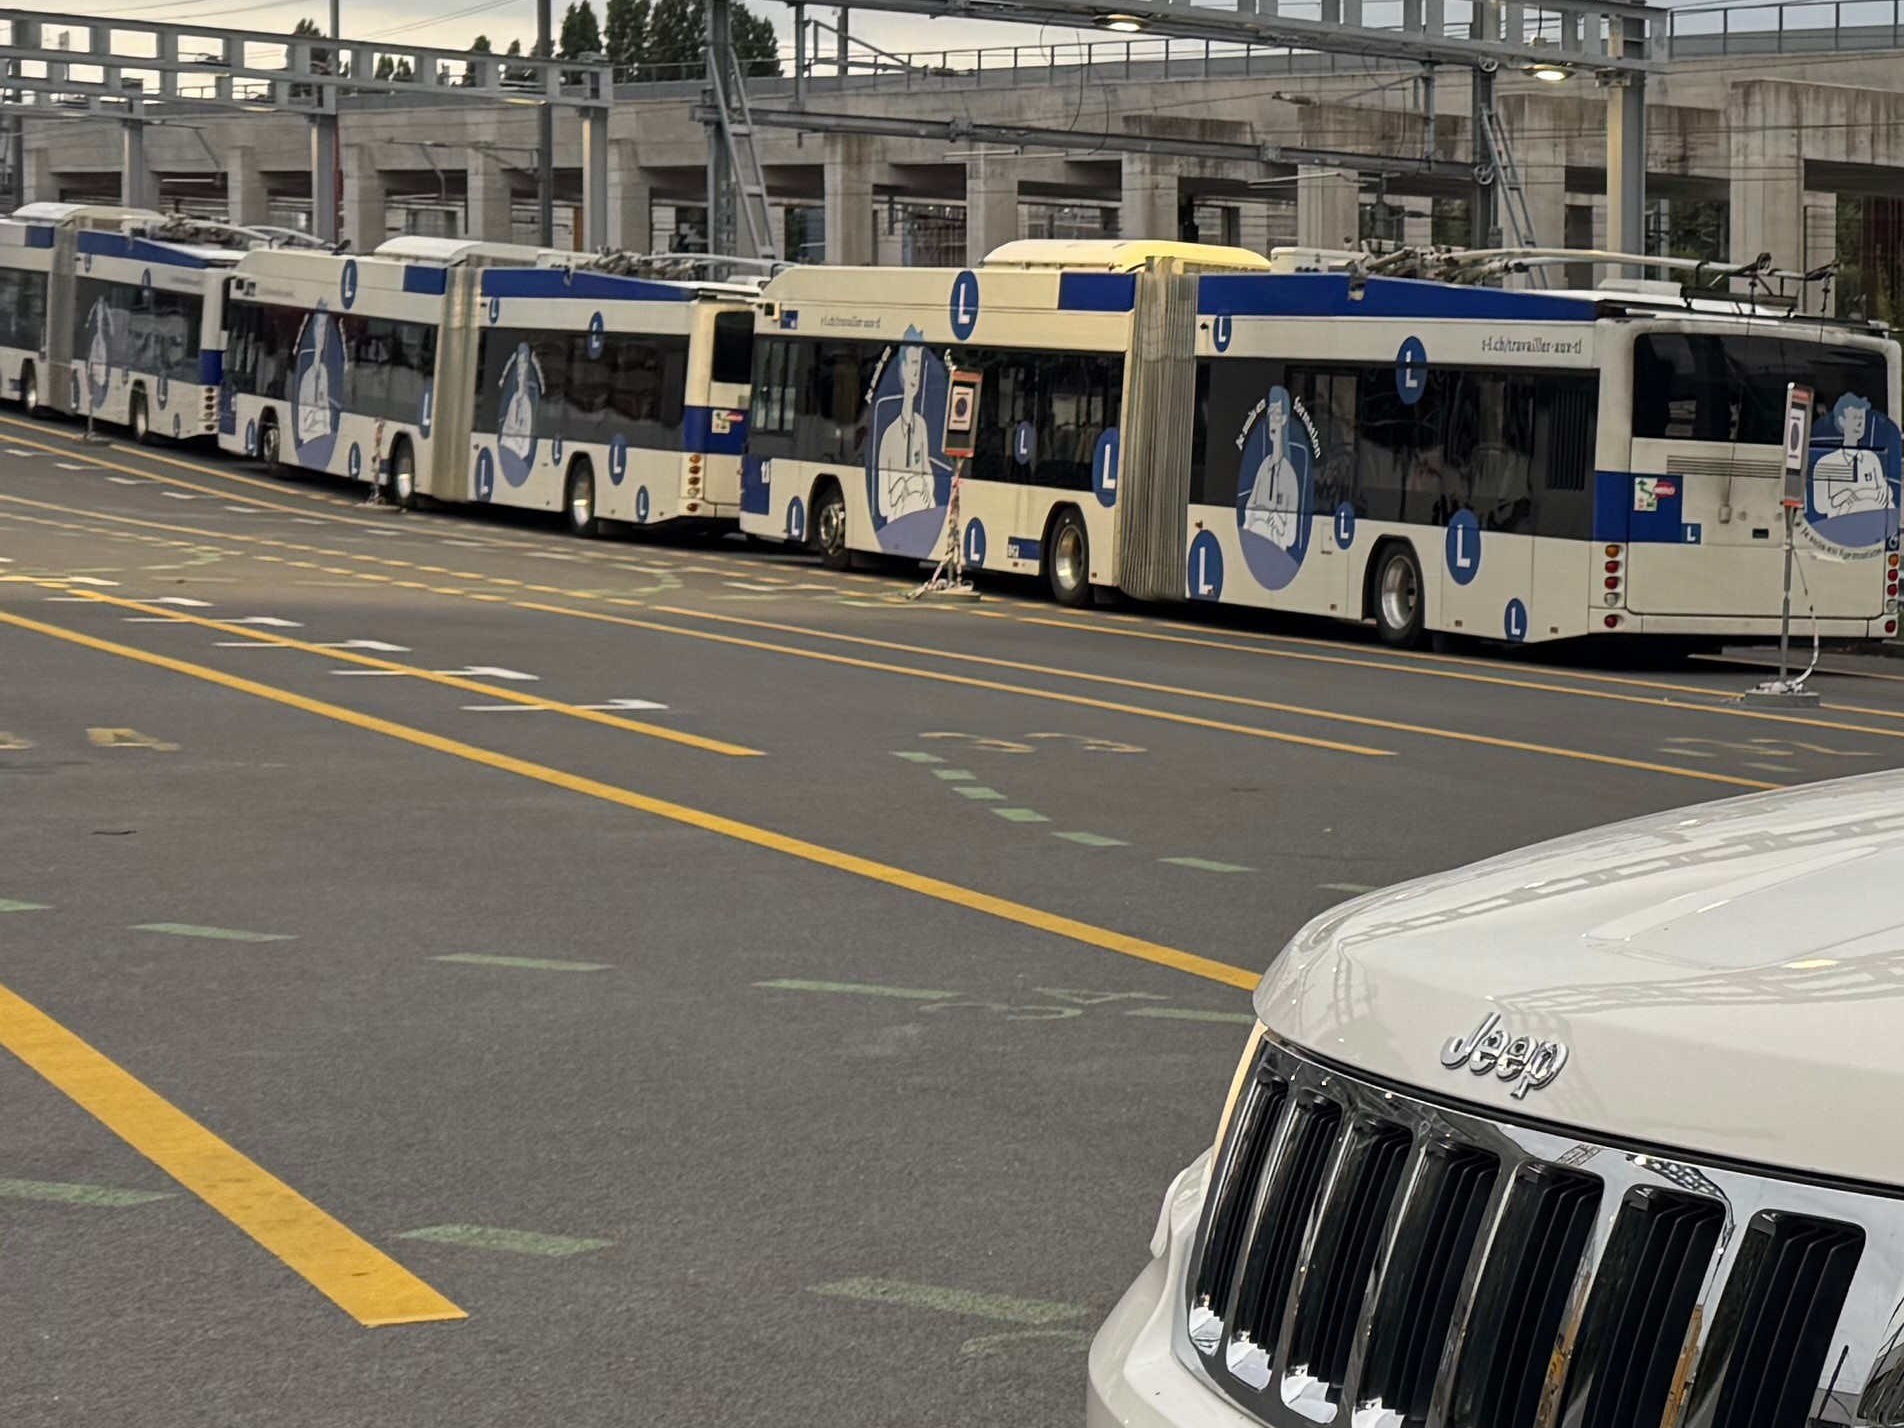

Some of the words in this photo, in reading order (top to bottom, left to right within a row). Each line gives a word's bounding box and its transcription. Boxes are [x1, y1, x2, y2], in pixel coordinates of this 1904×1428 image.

[957, 283, 970, 324] L
[1218, 316, 1227, 342] L
[1405, 351, 1418, 388] L
[1020, 430, 1027, 454] L
[614, 444, 622, 474] L
[1102, 444, 1116, 489] L
[481, 459, 489, 494] L
[791, 505, 799, 536] L
[1340, 511, 1349, 539] L
[1687, 526, 1696, 542] L
[970, 528, 980, 561] L
[1456, 524, 1471, 568] L
[1199, 547, 1213, 595] L
[1511, 606, 1521, 636] L
[1440, 1012, 1568, 1099] Jeep
